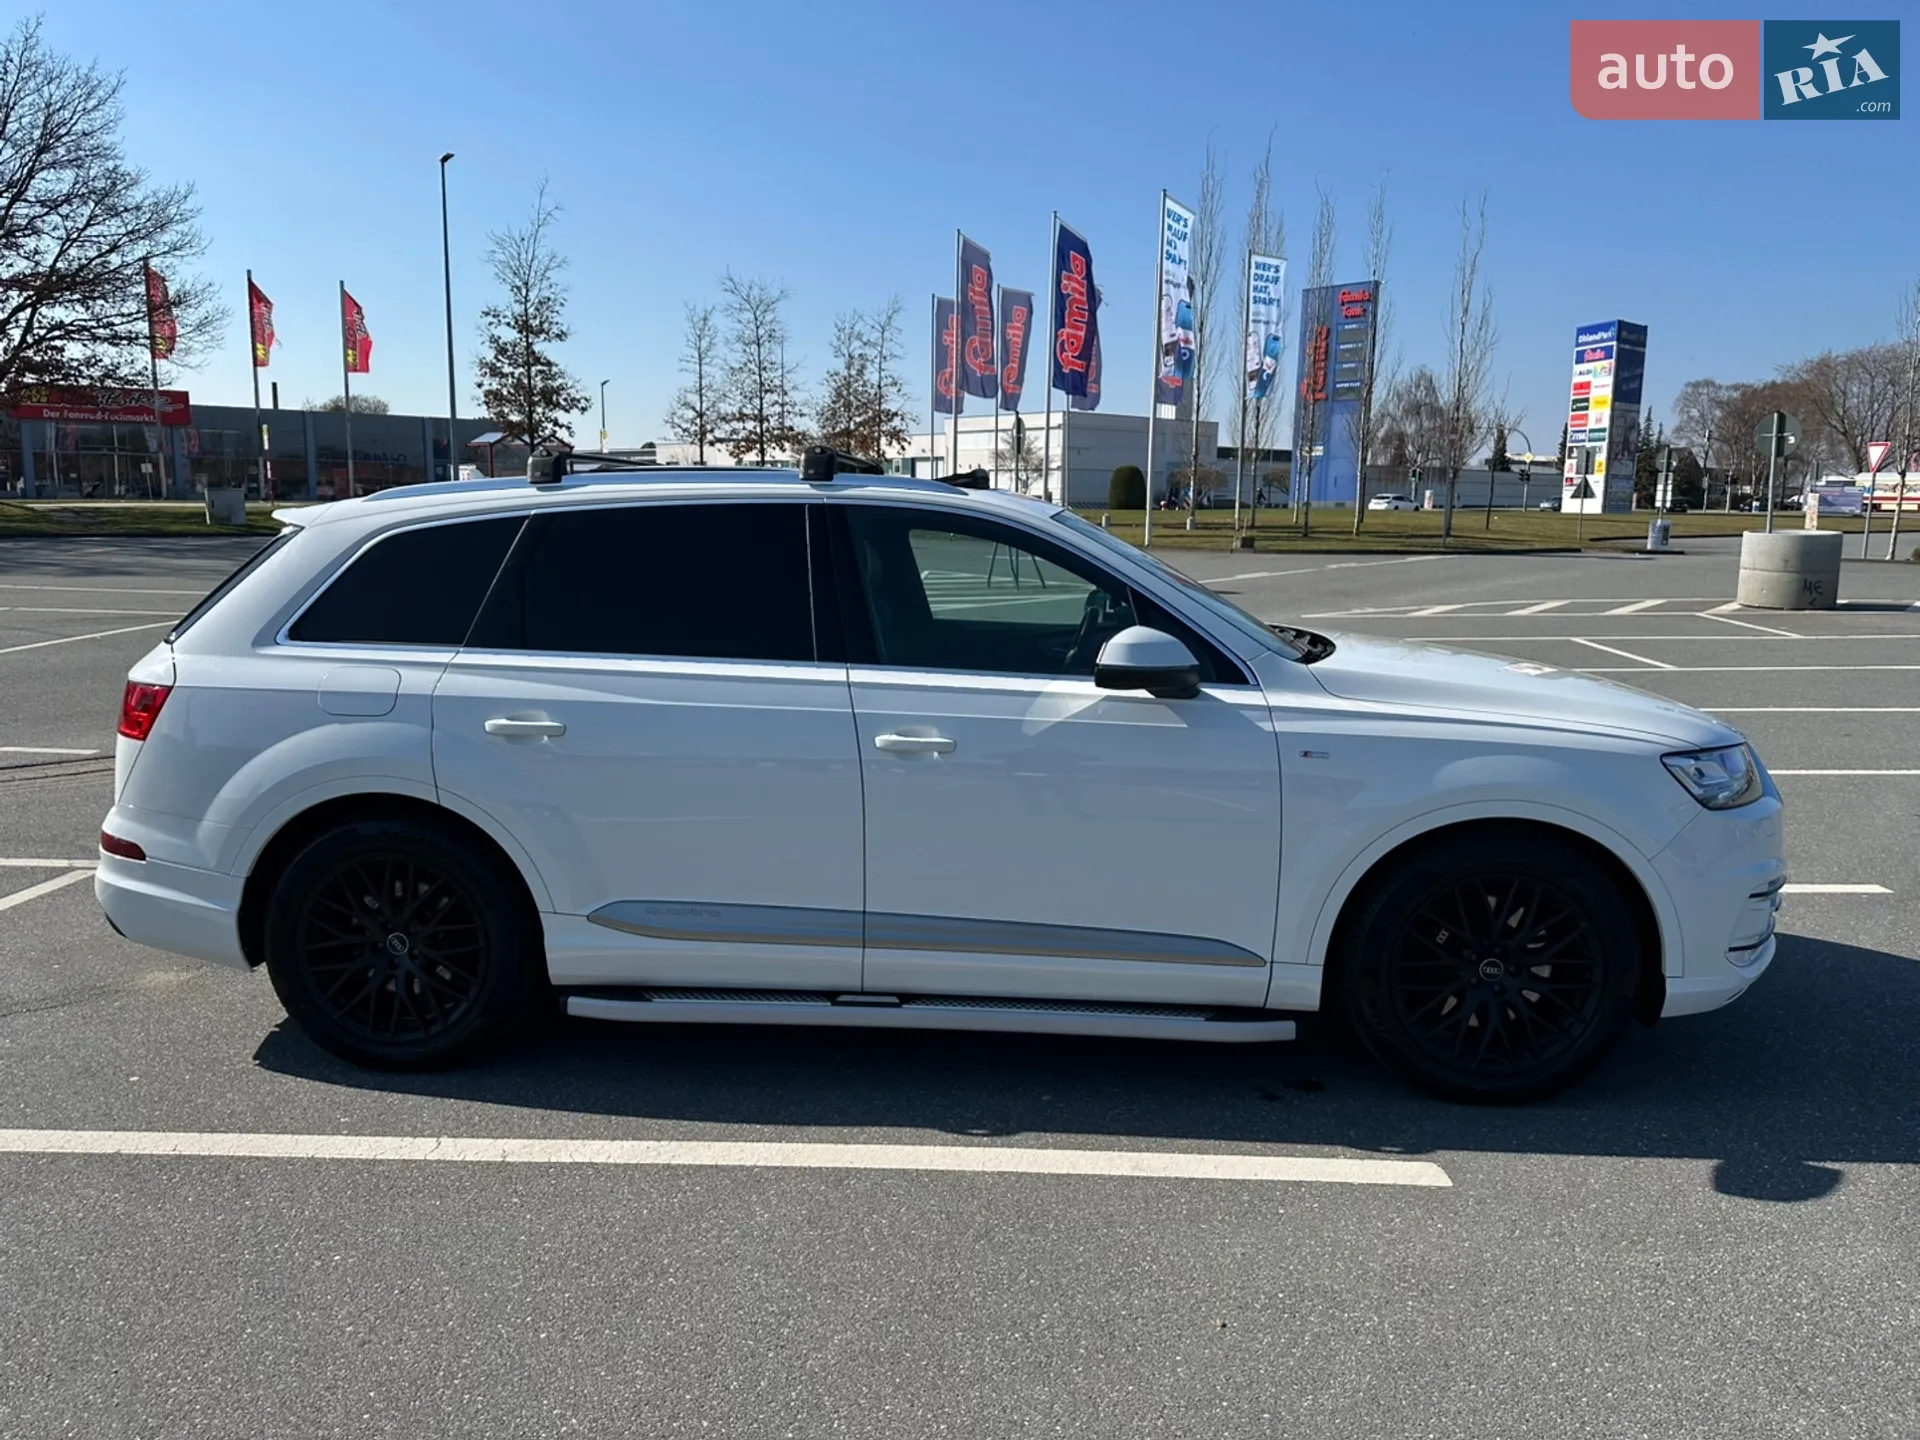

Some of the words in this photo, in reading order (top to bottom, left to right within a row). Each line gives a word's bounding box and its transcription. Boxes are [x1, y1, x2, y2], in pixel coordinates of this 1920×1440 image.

[965, 264, 997, 376] famila
[1003, 305, 1028, 395] famila
[1056, 251, 1088, 374] famila
[43, 409, 60, 418] Der
